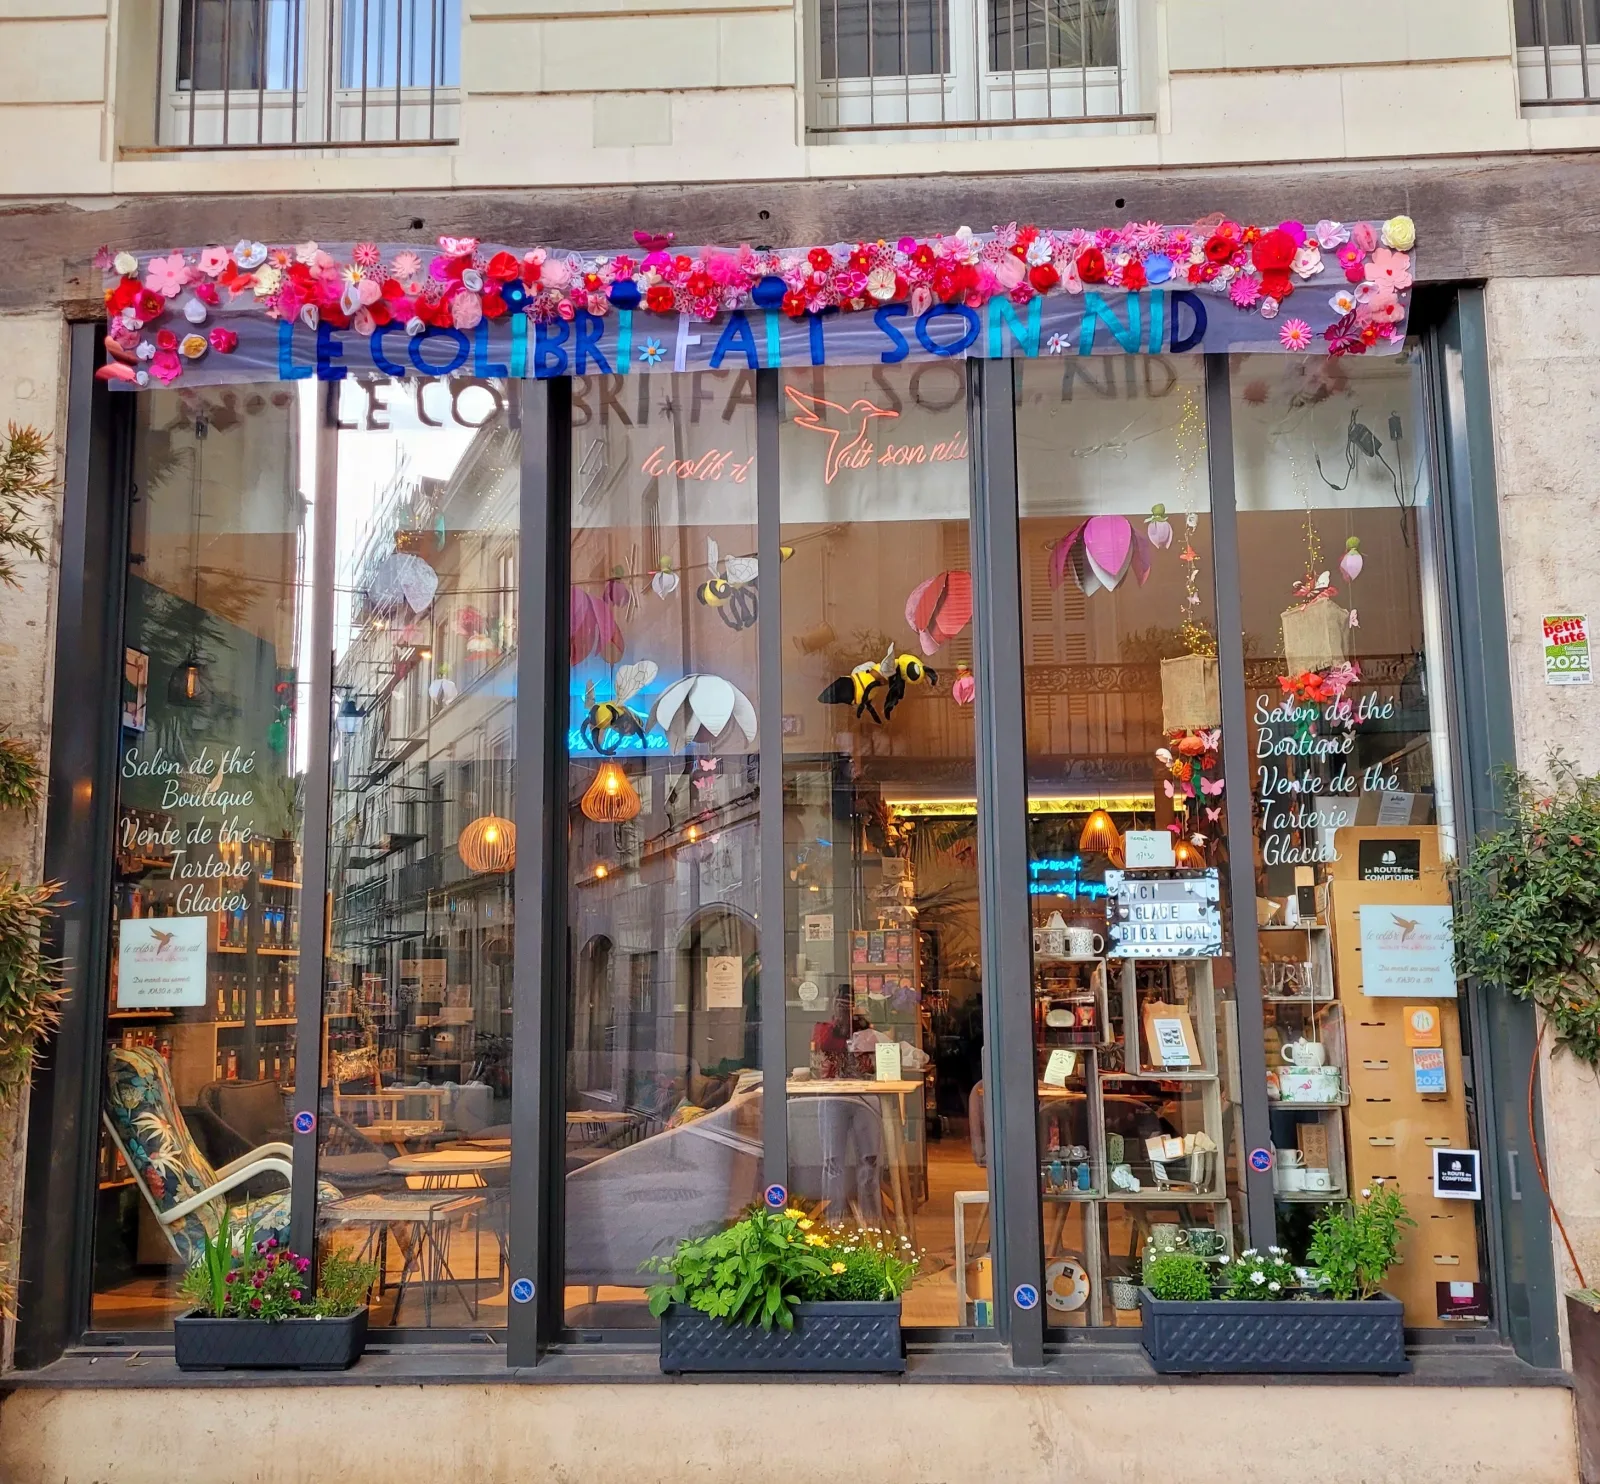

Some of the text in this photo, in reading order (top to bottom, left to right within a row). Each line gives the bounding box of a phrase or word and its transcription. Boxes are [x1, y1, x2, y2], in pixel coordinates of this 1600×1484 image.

[279, 318, 348, 381] LE
[873, 292, 1042, 364] SON
[1078, 288, 1208, 358] NID
[877, 443, 928, 467] son
[929, 430, 969, 462] nid
[1543, 618, 1583, 638] petit
[1552, 630, 1586, 646] futé
[1546, 655, 1590, 669] 2025
[1254, 691, 1395, 725] Salon de thé
[1256, 727, 1356, 763] Boutique
[122, 746, 256, 778] Salon de thé
[1257, 761, 1401, 797] Vente de thé
[161, 778, 254, 815] Boutique
[1259, 799, 1350, 831] Tarterie
[120, 815, 253, 848] Vente de thé
[168, 849, 252, 881] Tarterie
[1263, 834, 1344, 866] Glacier
[1364, 873, 1414, 881] COMPTOIRS
[1373, 865, 1402, 874] ROUTE
[176, 883, 251, 915] Glacier
[1130, 886, 1156, 900] ICI
[1135, 905, 1179, 920] GLACE
[1165, 925, 1210, 940] LOCAL
[1417, 1075, 1444, 1085] 2024
